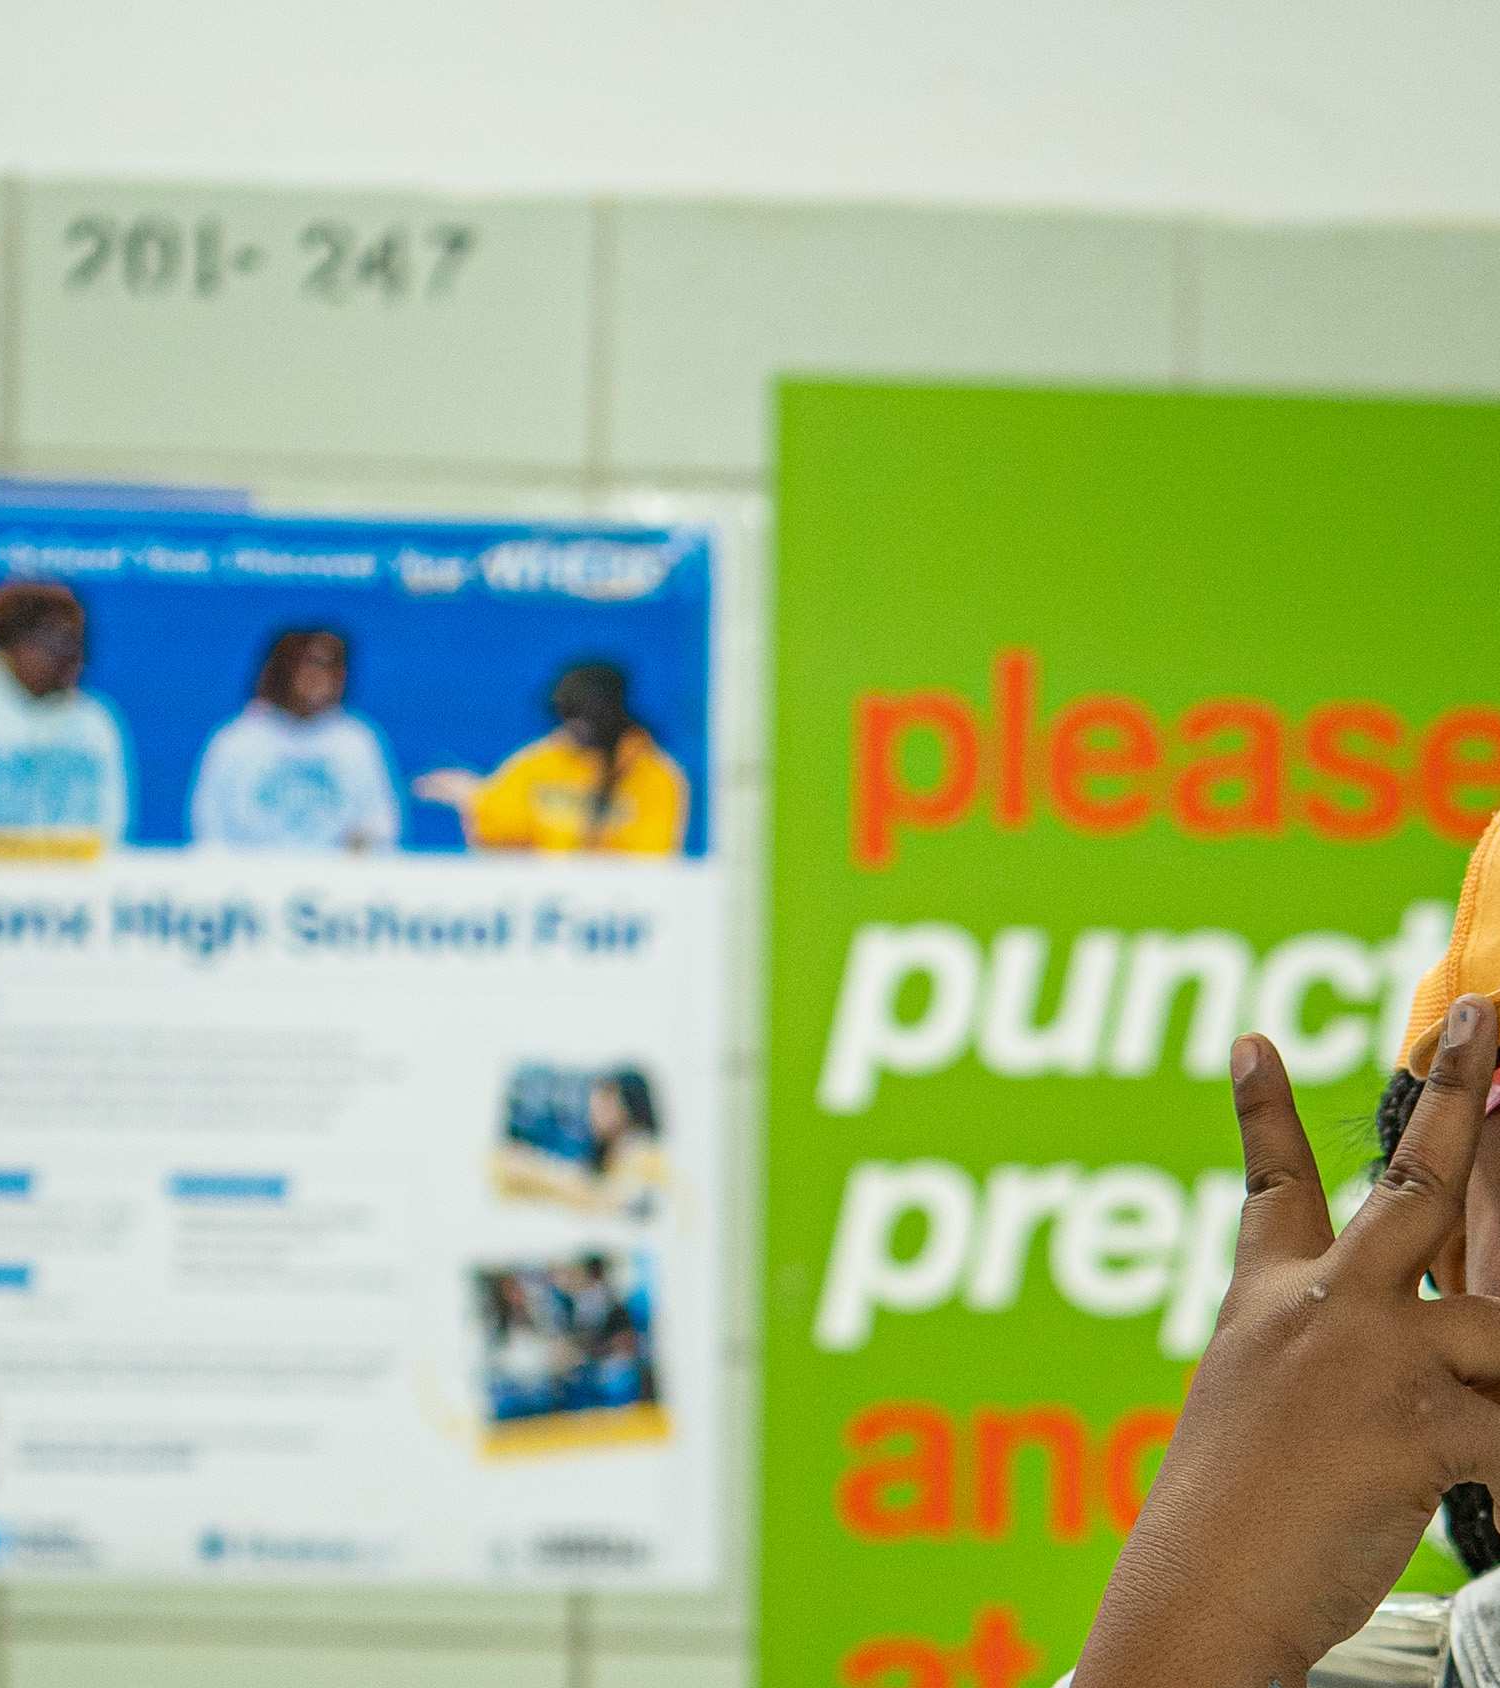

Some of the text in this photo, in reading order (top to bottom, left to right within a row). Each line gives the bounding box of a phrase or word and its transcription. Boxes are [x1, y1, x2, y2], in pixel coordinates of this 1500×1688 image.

[297, 222, 475, 300] 247
[111, 898, 262, 964] High
[288, 898, 508, 957] School
[533, 905, 649, 957] Fair
